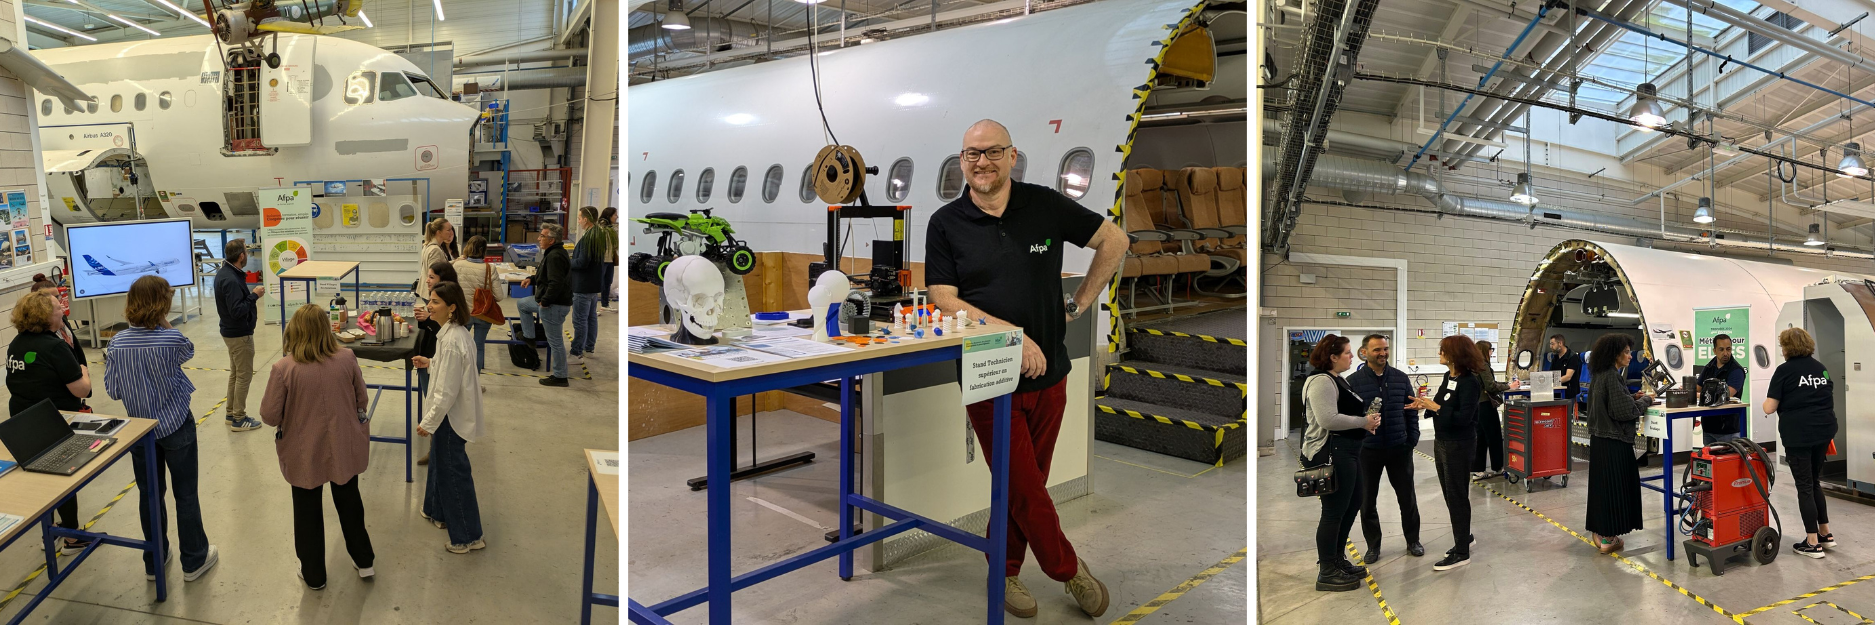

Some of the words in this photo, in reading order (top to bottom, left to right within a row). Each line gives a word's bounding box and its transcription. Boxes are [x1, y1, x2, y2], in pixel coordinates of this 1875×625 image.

[277, 194, 295, 203] Afpa
[1029, 243, 1049, 254] Afpa
[1712, 316, 1727, 325] Afpa
[972, 360, 986, 369] Stand
[987, 357, 1013, 366] Technicien
[969, 381, 995, 390] fabrication
[1798, 374, 1828, 389] Afpa
